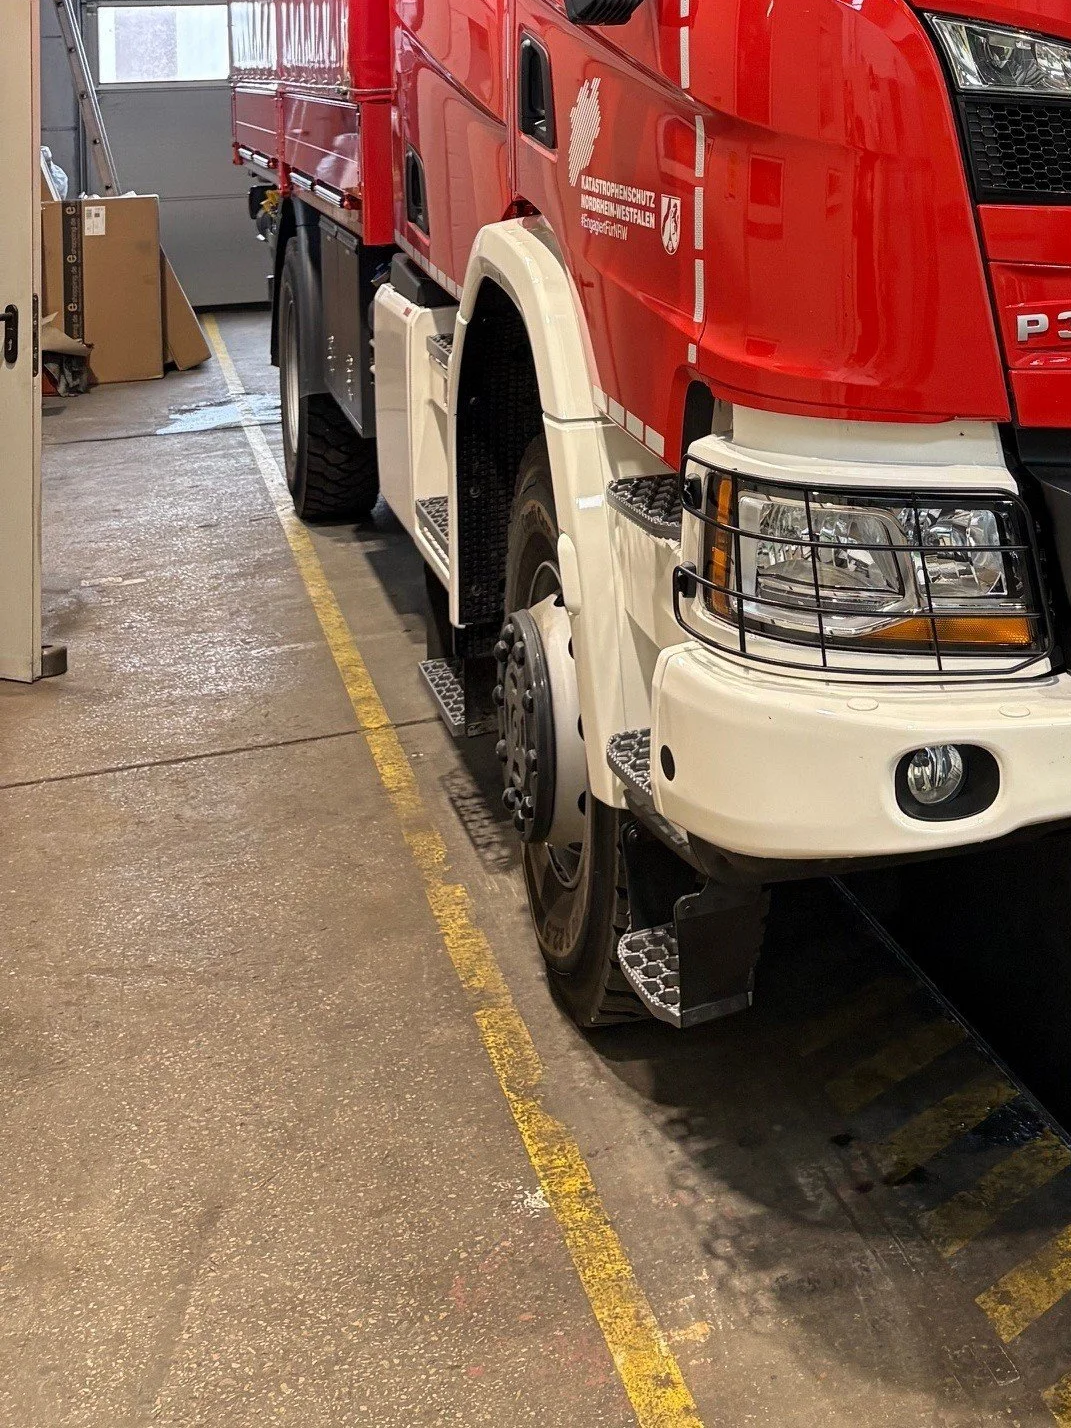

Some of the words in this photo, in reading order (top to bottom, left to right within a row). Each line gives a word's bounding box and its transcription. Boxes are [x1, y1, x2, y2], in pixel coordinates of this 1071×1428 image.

[580, 174, 656, 208] KATASTROPHENSCHUTZ
[580, 193, 656, 229] NORDRHEIN-WESTFALEN
[1017, 313, 1049, 342] P
